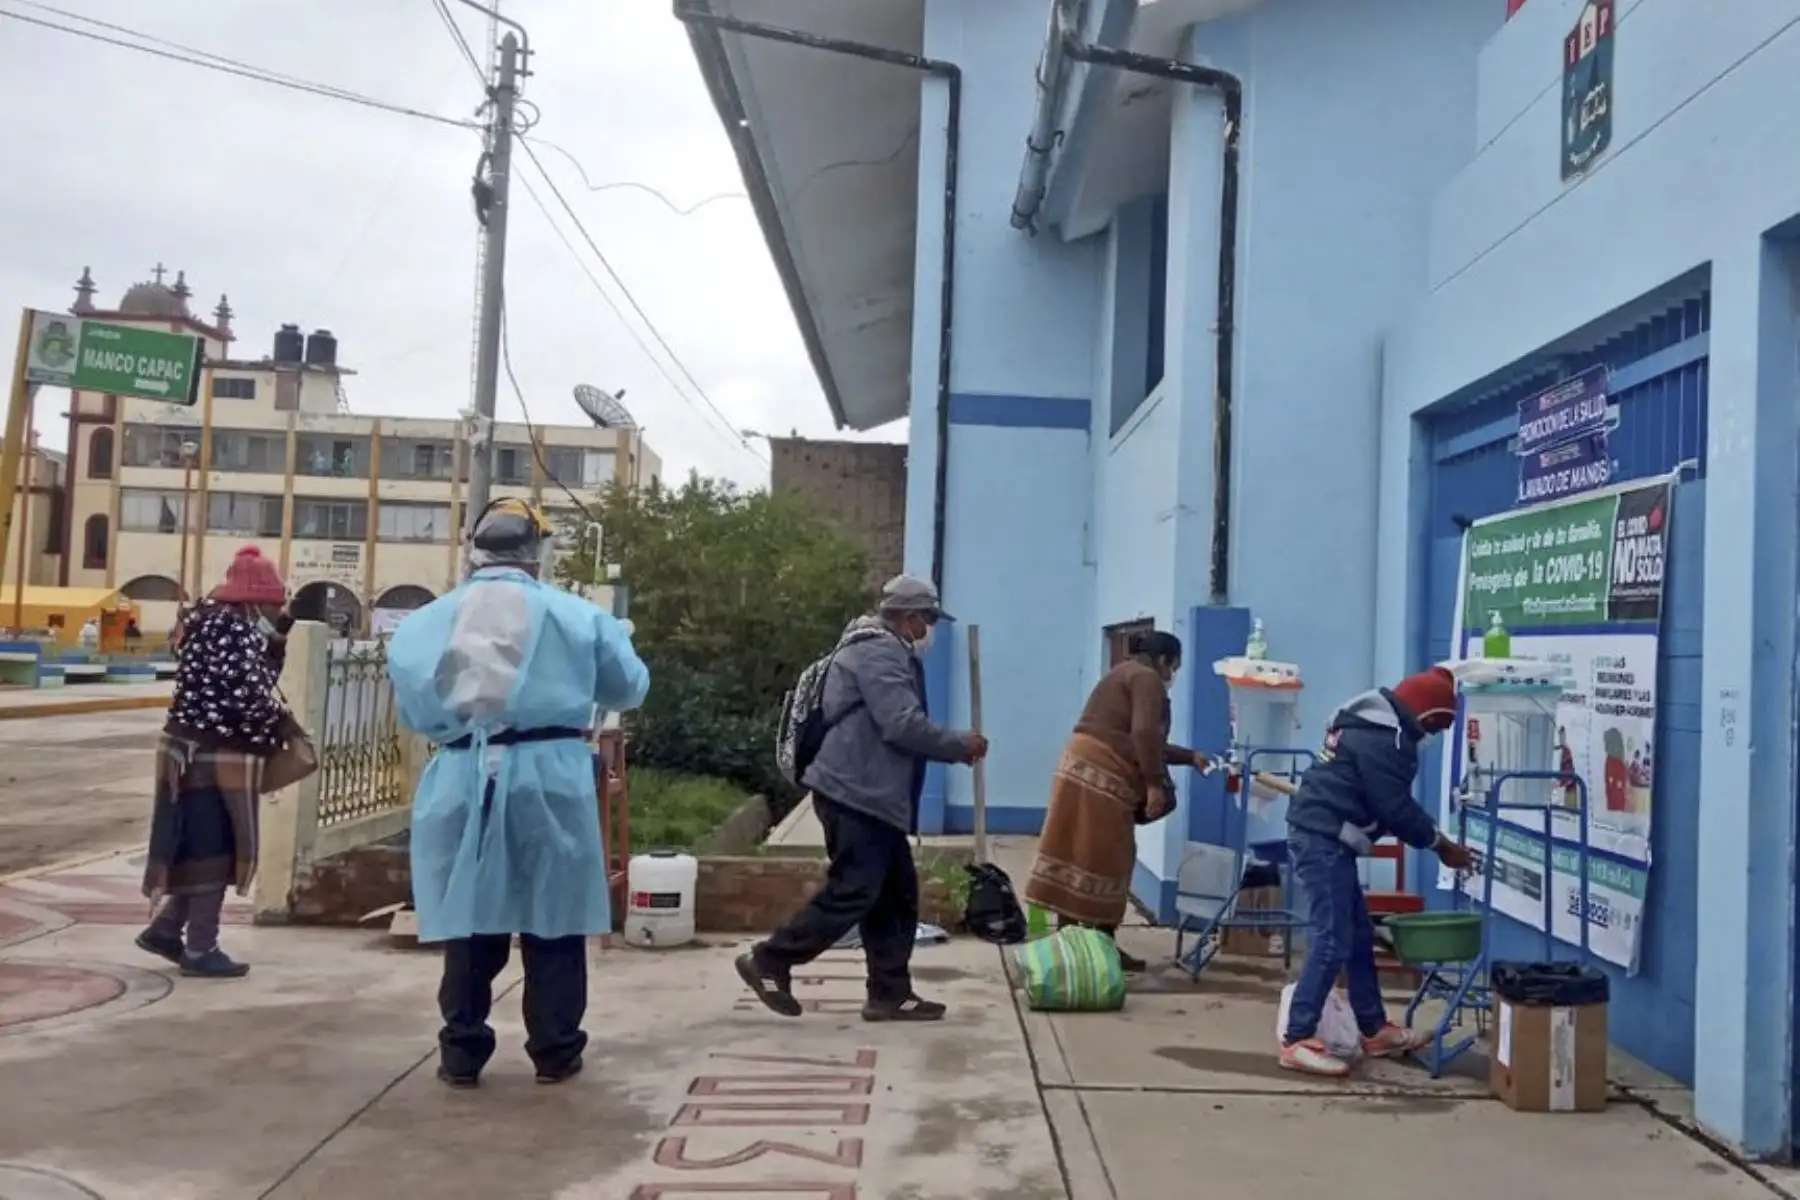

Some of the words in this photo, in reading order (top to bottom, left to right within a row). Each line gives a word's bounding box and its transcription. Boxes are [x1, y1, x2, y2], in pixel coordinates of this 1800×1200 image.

[83, 348, 134, 374] MANCO
[137, 355, 184, 381] CAPAC
[1545, 550, 1603, 584] COVID-19
[1614, 537, 1636, 584] NO
